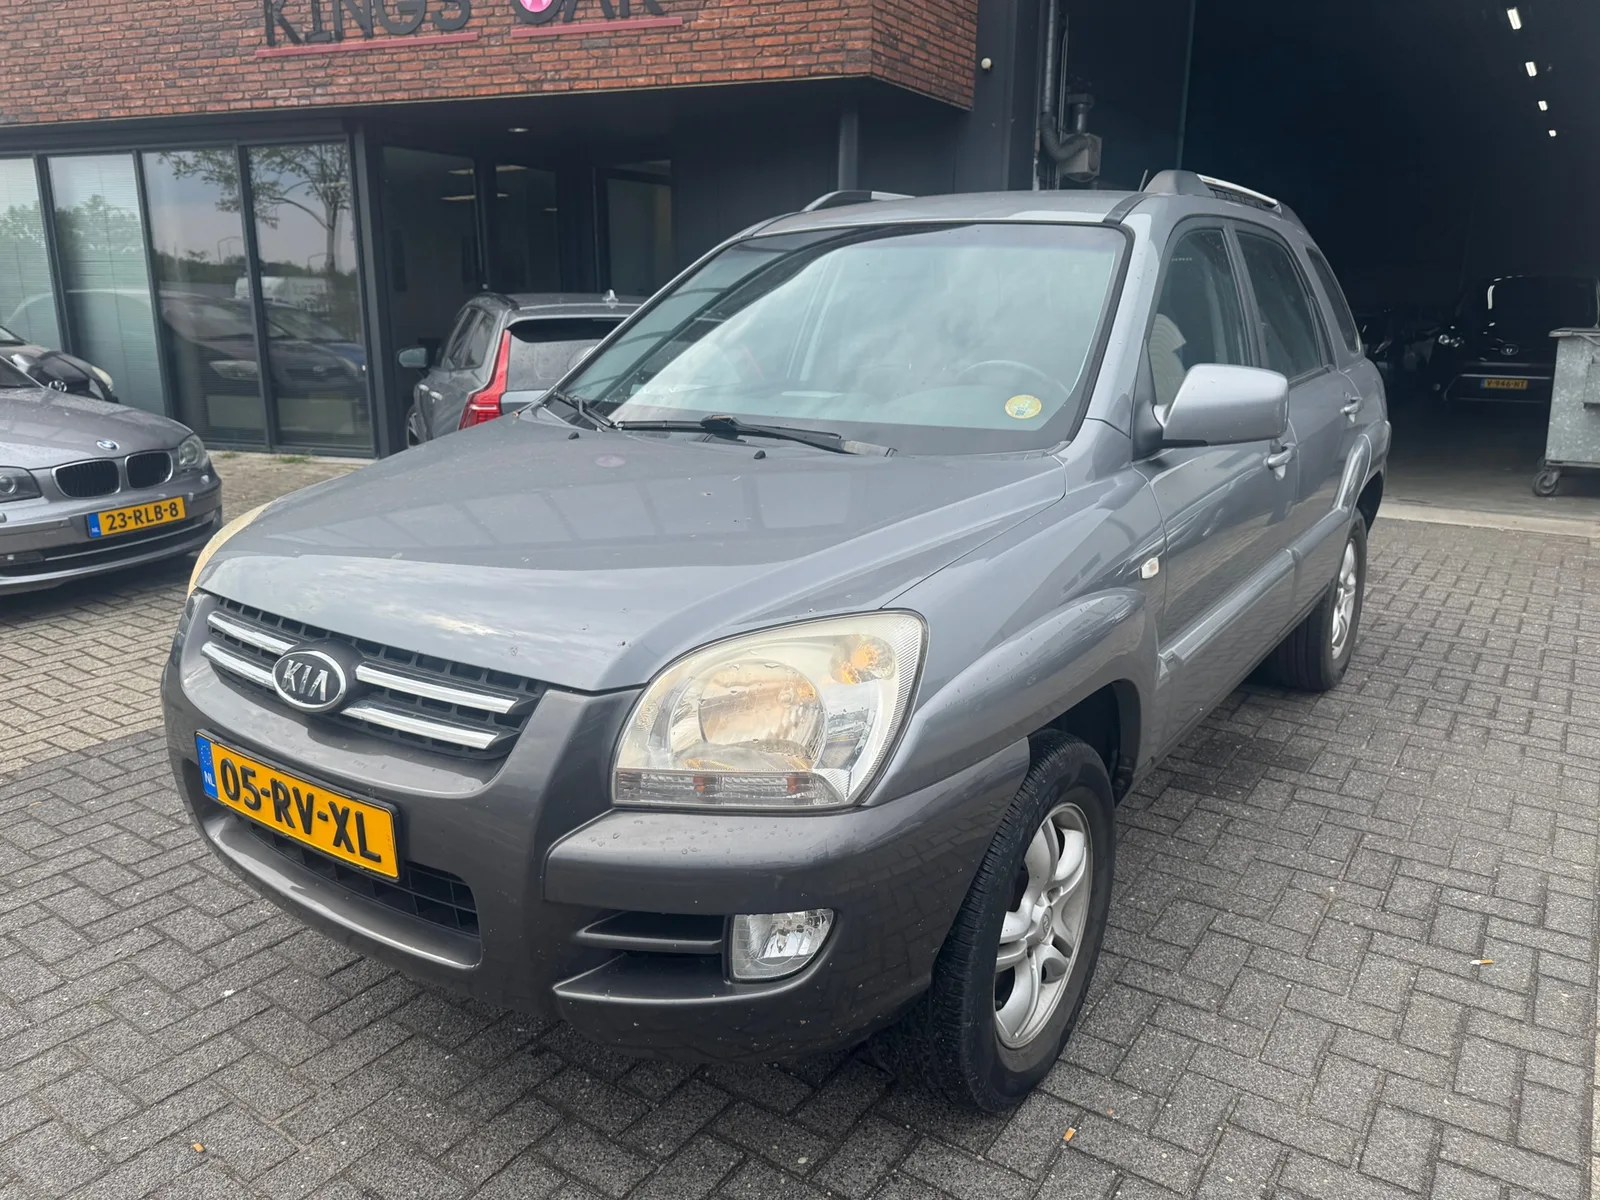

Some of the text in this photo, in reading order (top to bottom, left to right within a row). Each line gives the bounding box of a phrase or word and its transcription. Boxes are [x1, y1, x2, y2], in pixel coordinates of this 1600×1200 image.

[106, 502, 179, 530] 23-RLB-8
[280, 654, 329, 701] KIA
[204, 758, 381, 863] NL 05-RV-XL
